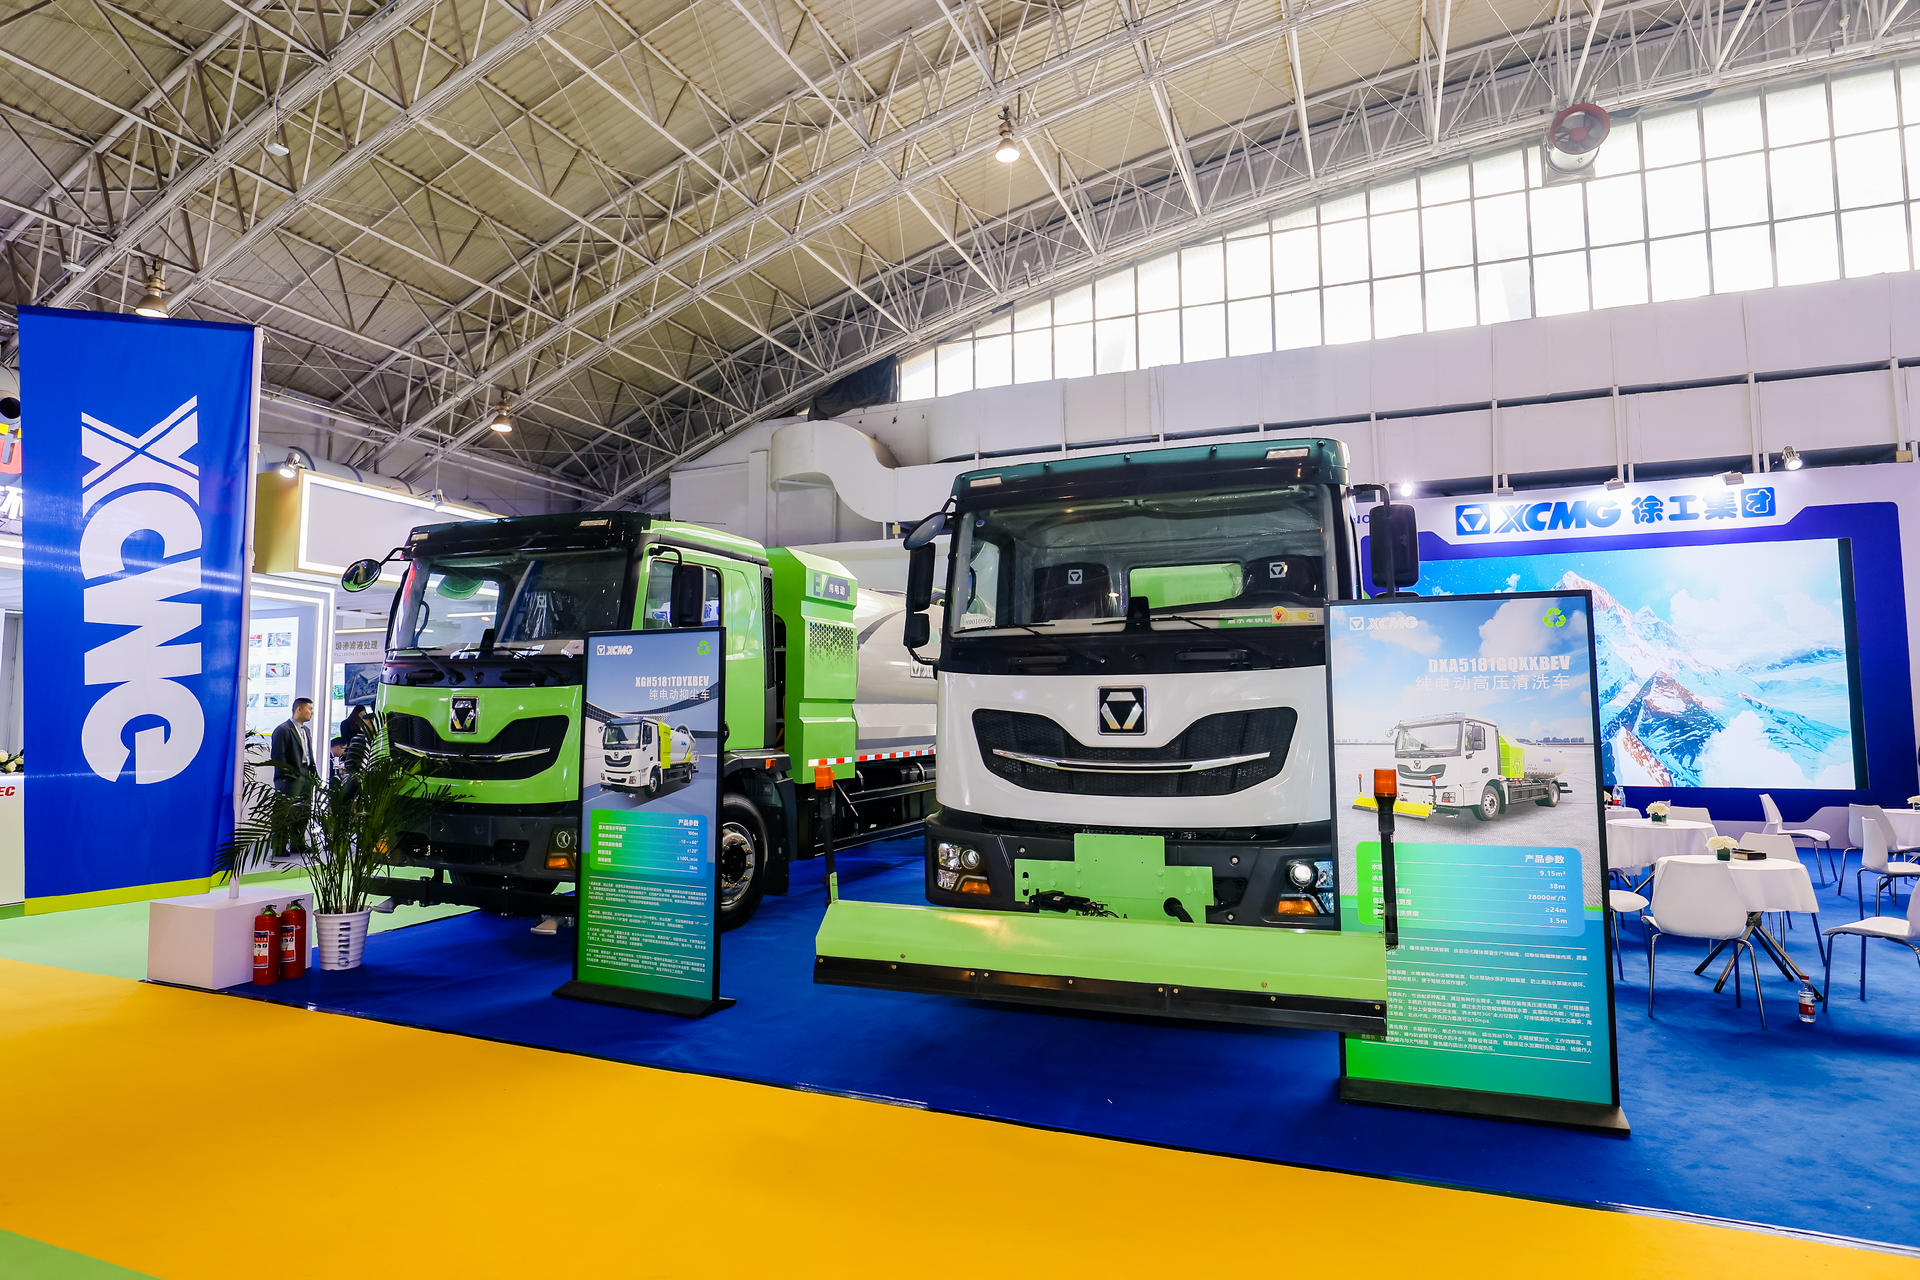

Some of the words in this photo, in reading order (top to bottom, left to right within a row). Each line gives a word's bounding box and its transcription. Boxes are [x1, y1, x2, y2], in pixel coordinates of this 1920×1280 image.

[1631, 486, 1776, 525] 徐工集团
[1493, 500, 1621, 533] XCMG
[80, 395, 205, 785] XCMG
[1366, 616, 1418, 631] XCMG
[606, 645, 633, 655] XCMG
[1415, 673, 1570, 691] 纯电动高压清洗车
[649, 687, 710, 701] 纯电动抑尘车
[1524, 854, 1565, 864] 产品参数
